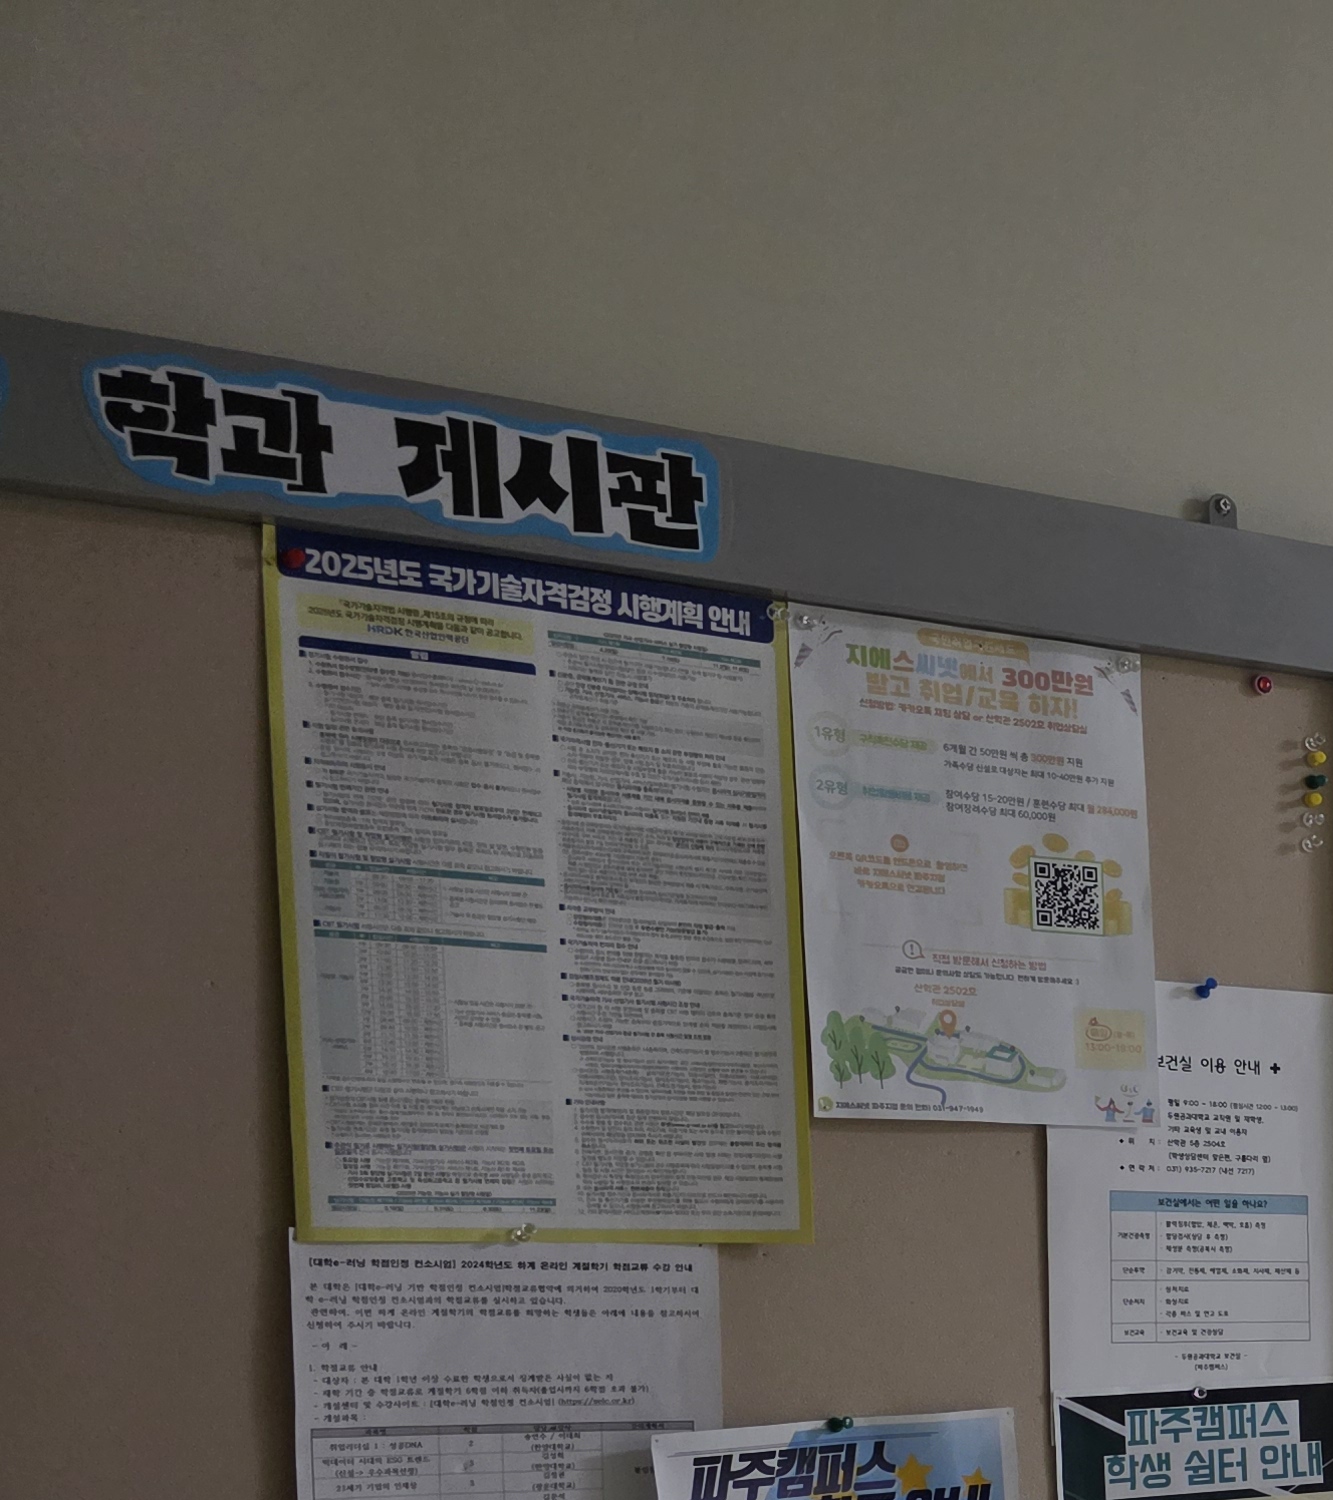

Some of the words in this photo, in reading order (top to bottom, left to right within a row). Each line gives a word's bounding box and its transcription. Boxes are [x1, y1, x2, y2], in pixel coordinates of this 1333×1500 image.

[97, 370, 335, 493] 학과
[395, 416, 705, 551] 게시판
[304, 548, 423, 588] 2025년도
[428, 563, 612, 616] 국가기술자격검정
[617, 592, 703, 629] 시행계획
[708, 605, 751, 636] 안내
[845, 643, 993, 684] 지에스씨넷에서
[1002, 667, 1094, 696] 300만원
[866, 672, 910, 698] 받고
[919, 678, 1019, 712] 취업/교육
[1029, 692, 1078, 719] 하자!
[813, 726, 846, 743] 1유형
[815, 779, 849, 796] 2유형
[1200, 1058, 1227, 1074] 이용
[1234, 1059, 1260, 1075] 안내
[1127, 1402, 1290, 1446] 파주캠퍼스
[1106, 1452, 1172, 1490] 학생
[1184, 1447, 1248, 1486] 쉼터
[1259, 1442, 1322, 1480] 안내
